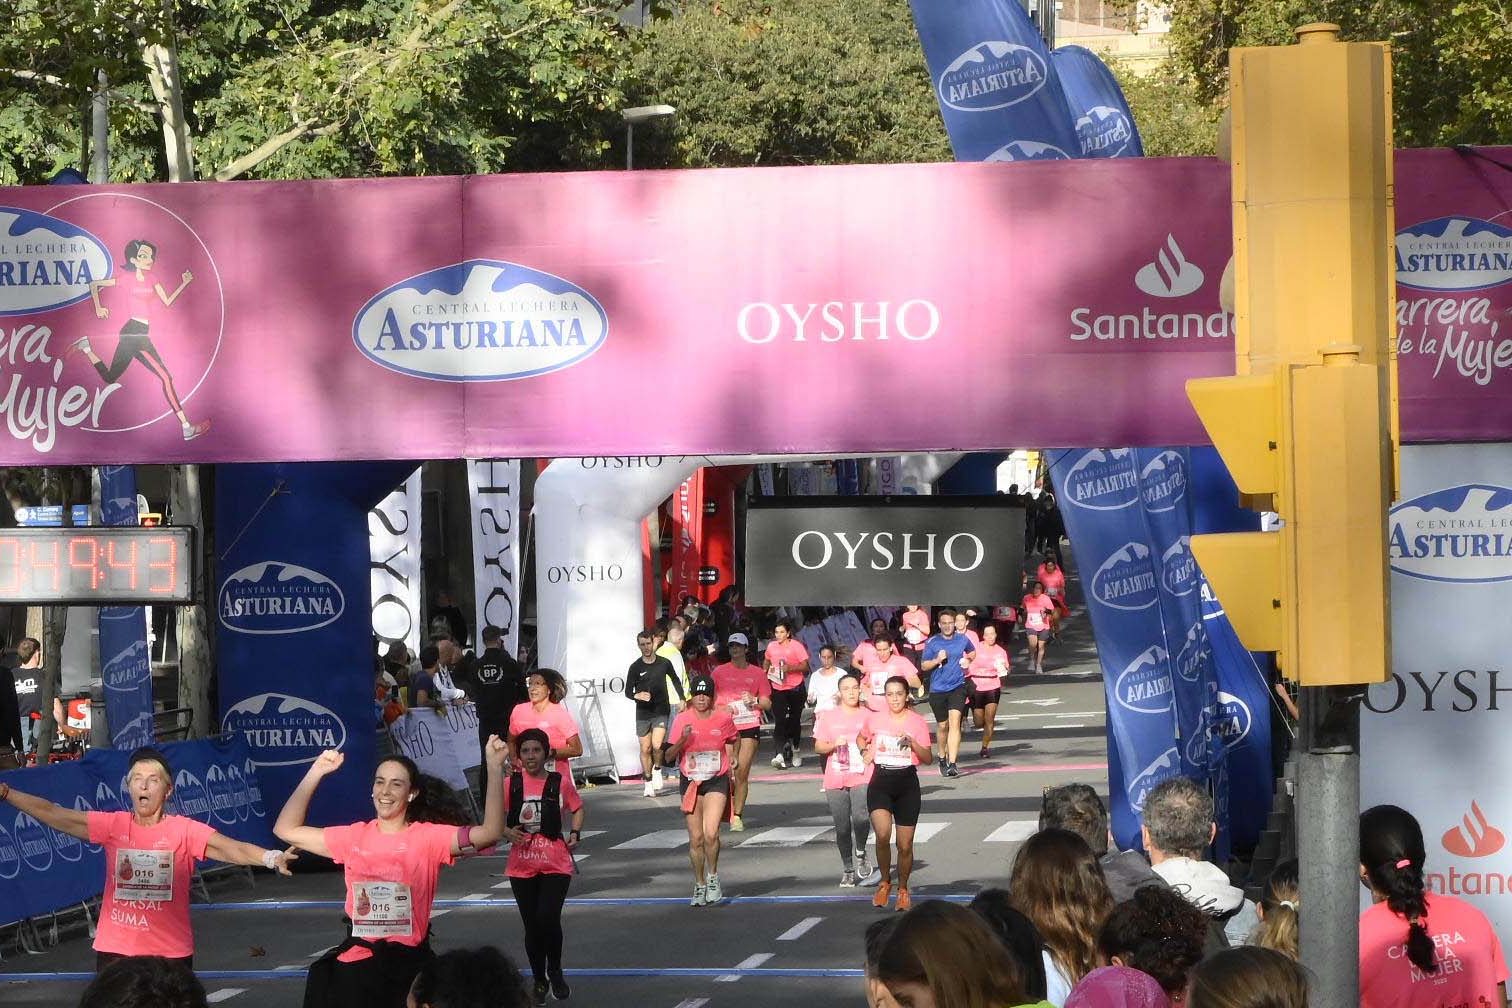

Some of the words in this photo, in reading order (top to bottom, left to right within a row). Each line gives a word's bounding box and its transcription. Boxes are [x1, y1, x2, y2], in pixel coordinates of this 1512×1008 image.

[15, 243, 88, 255] LECHERA
[1409, 242, 1462, 250] CENTRAL
[411, 302, 490, 316] CENTRAL
[497, 300, 581, 314] LECHERA
[1395, 296, 1492, 326] arrera
[373, 306, 588, 352] ASTURIANA
[736, 300, 940, 343] OYSHO
[1070, 307, 1236, 341] Santand
[1419, 328, 1437, 355] la
[1415, 519, 1486, 530] CENTRAL
[792, 531, 985, 571] OYSHO
[547, 564, 623, 584] OYSHO
[282, 586, 331, 594] LECHERA
[222, 590, 335, 619] ASTURIANA
[484, 668, 498, 678] BP
[283, 718, 331, 726] LECHERA
[134, 869, 154, 878] 016
[372, 903, 390, 912] 016
[111, 908, 149, 927] SUMA
[1388, 931, 1466, 960] CAERA
